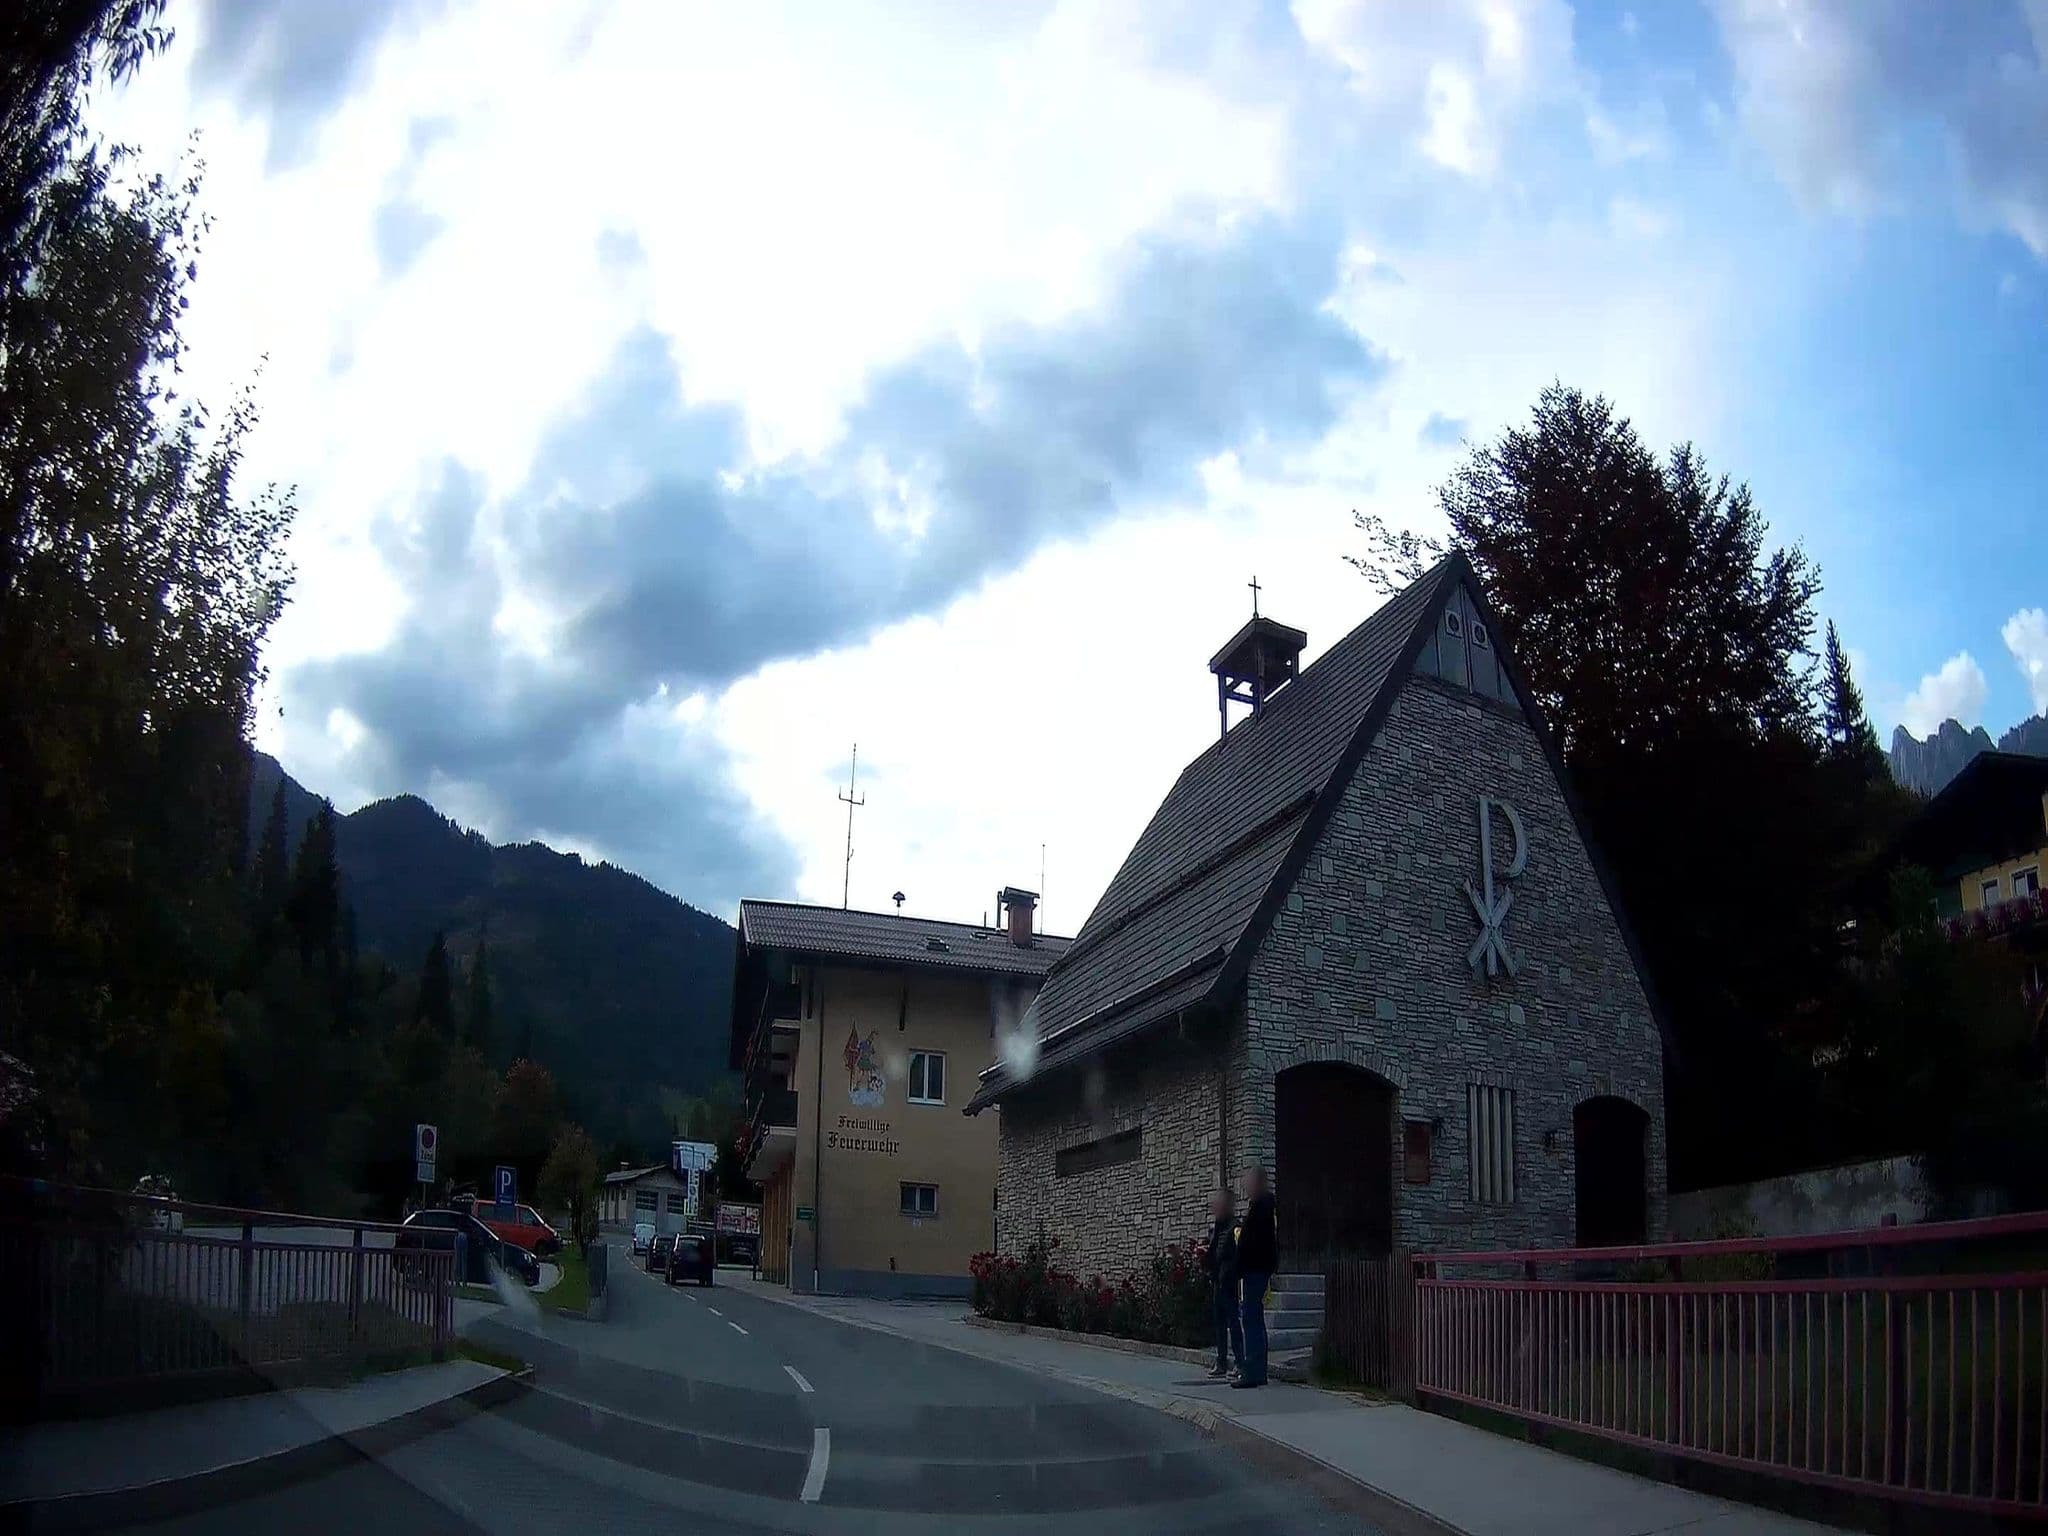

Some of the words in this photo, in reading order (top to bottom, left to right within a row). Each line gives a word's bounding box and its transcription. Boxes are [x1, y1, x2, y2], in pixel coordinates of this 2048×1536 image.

[838, 1115, 890, 1134] Freiwillige
[827, 1131, 900, 1156] Feuerwehr
[501, 1170, 512, 1194] P
